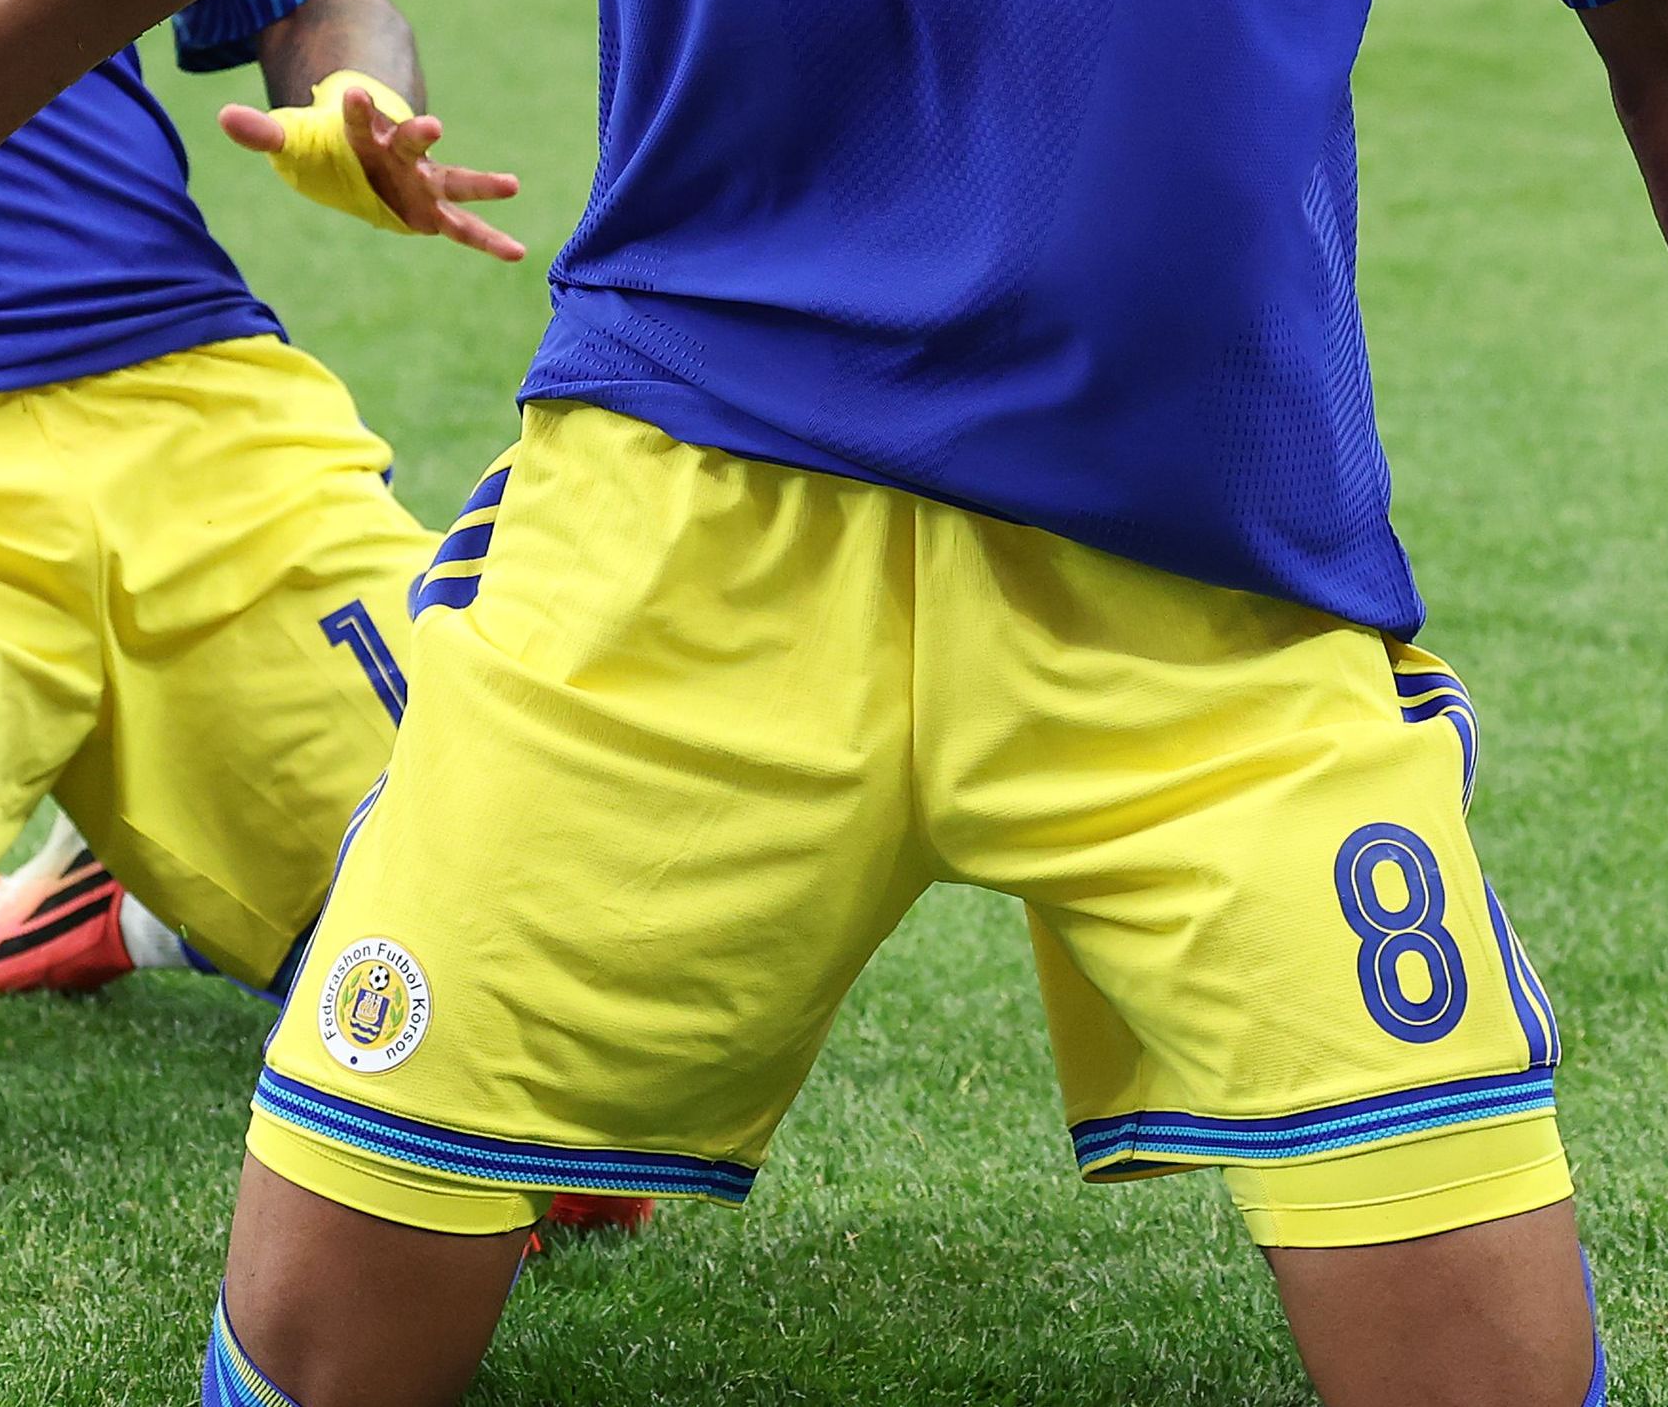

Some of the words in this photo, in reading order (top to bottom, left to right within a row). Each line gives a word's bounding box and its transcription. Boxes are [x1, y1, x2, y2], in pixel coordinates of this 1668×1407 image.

[377, 943, 423, 991] Futbòl
[1334, 822, 1468, 1044] 8
[322, 945, 372, 1041] Federashon
[385, 998, 427, 1060] Kòrsou
